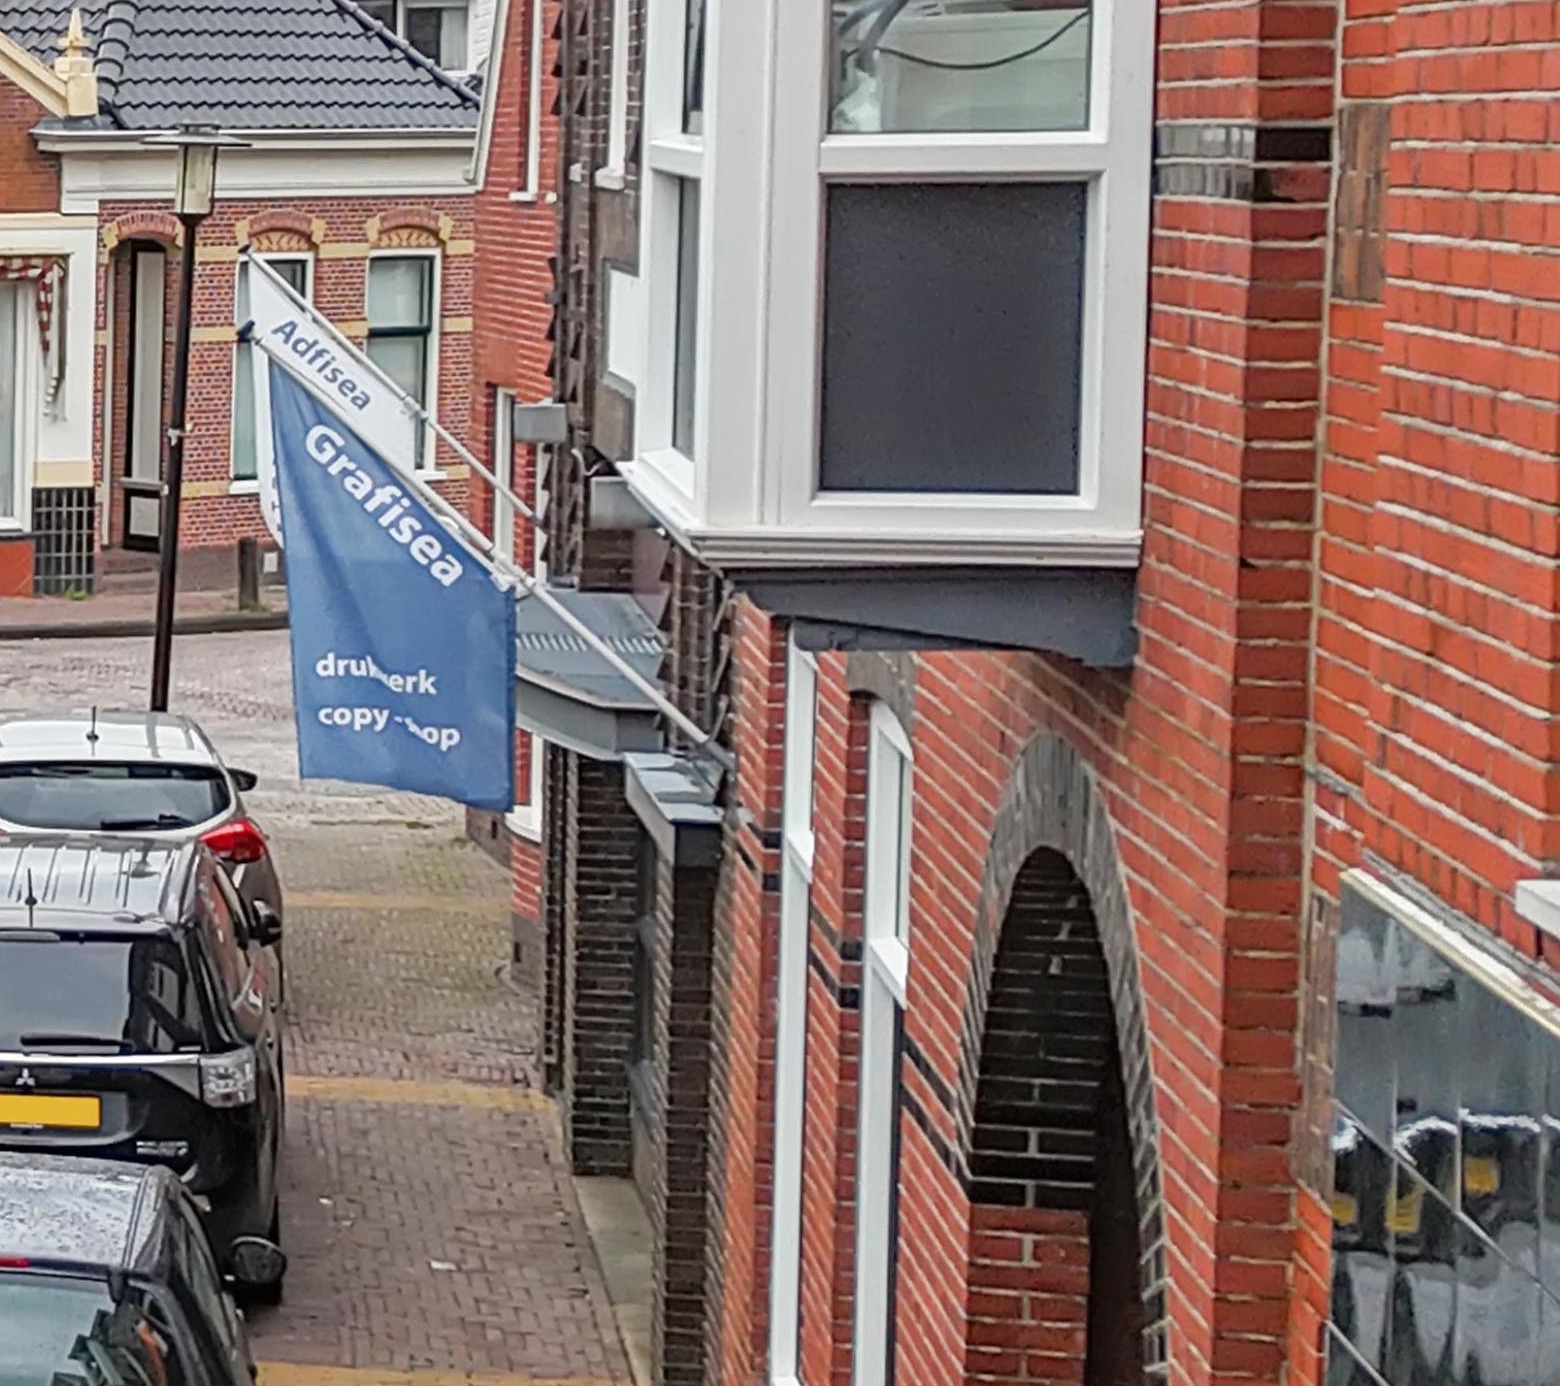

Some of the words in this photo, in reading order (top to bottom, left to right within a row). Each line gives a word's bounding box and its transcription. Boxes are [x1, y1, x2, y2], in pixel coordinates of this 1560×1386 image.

[271, 318, 373, 412] Adfisea
[303, 423, 465, 589] Grafisea
[315, 652, 438, 695] druerk
